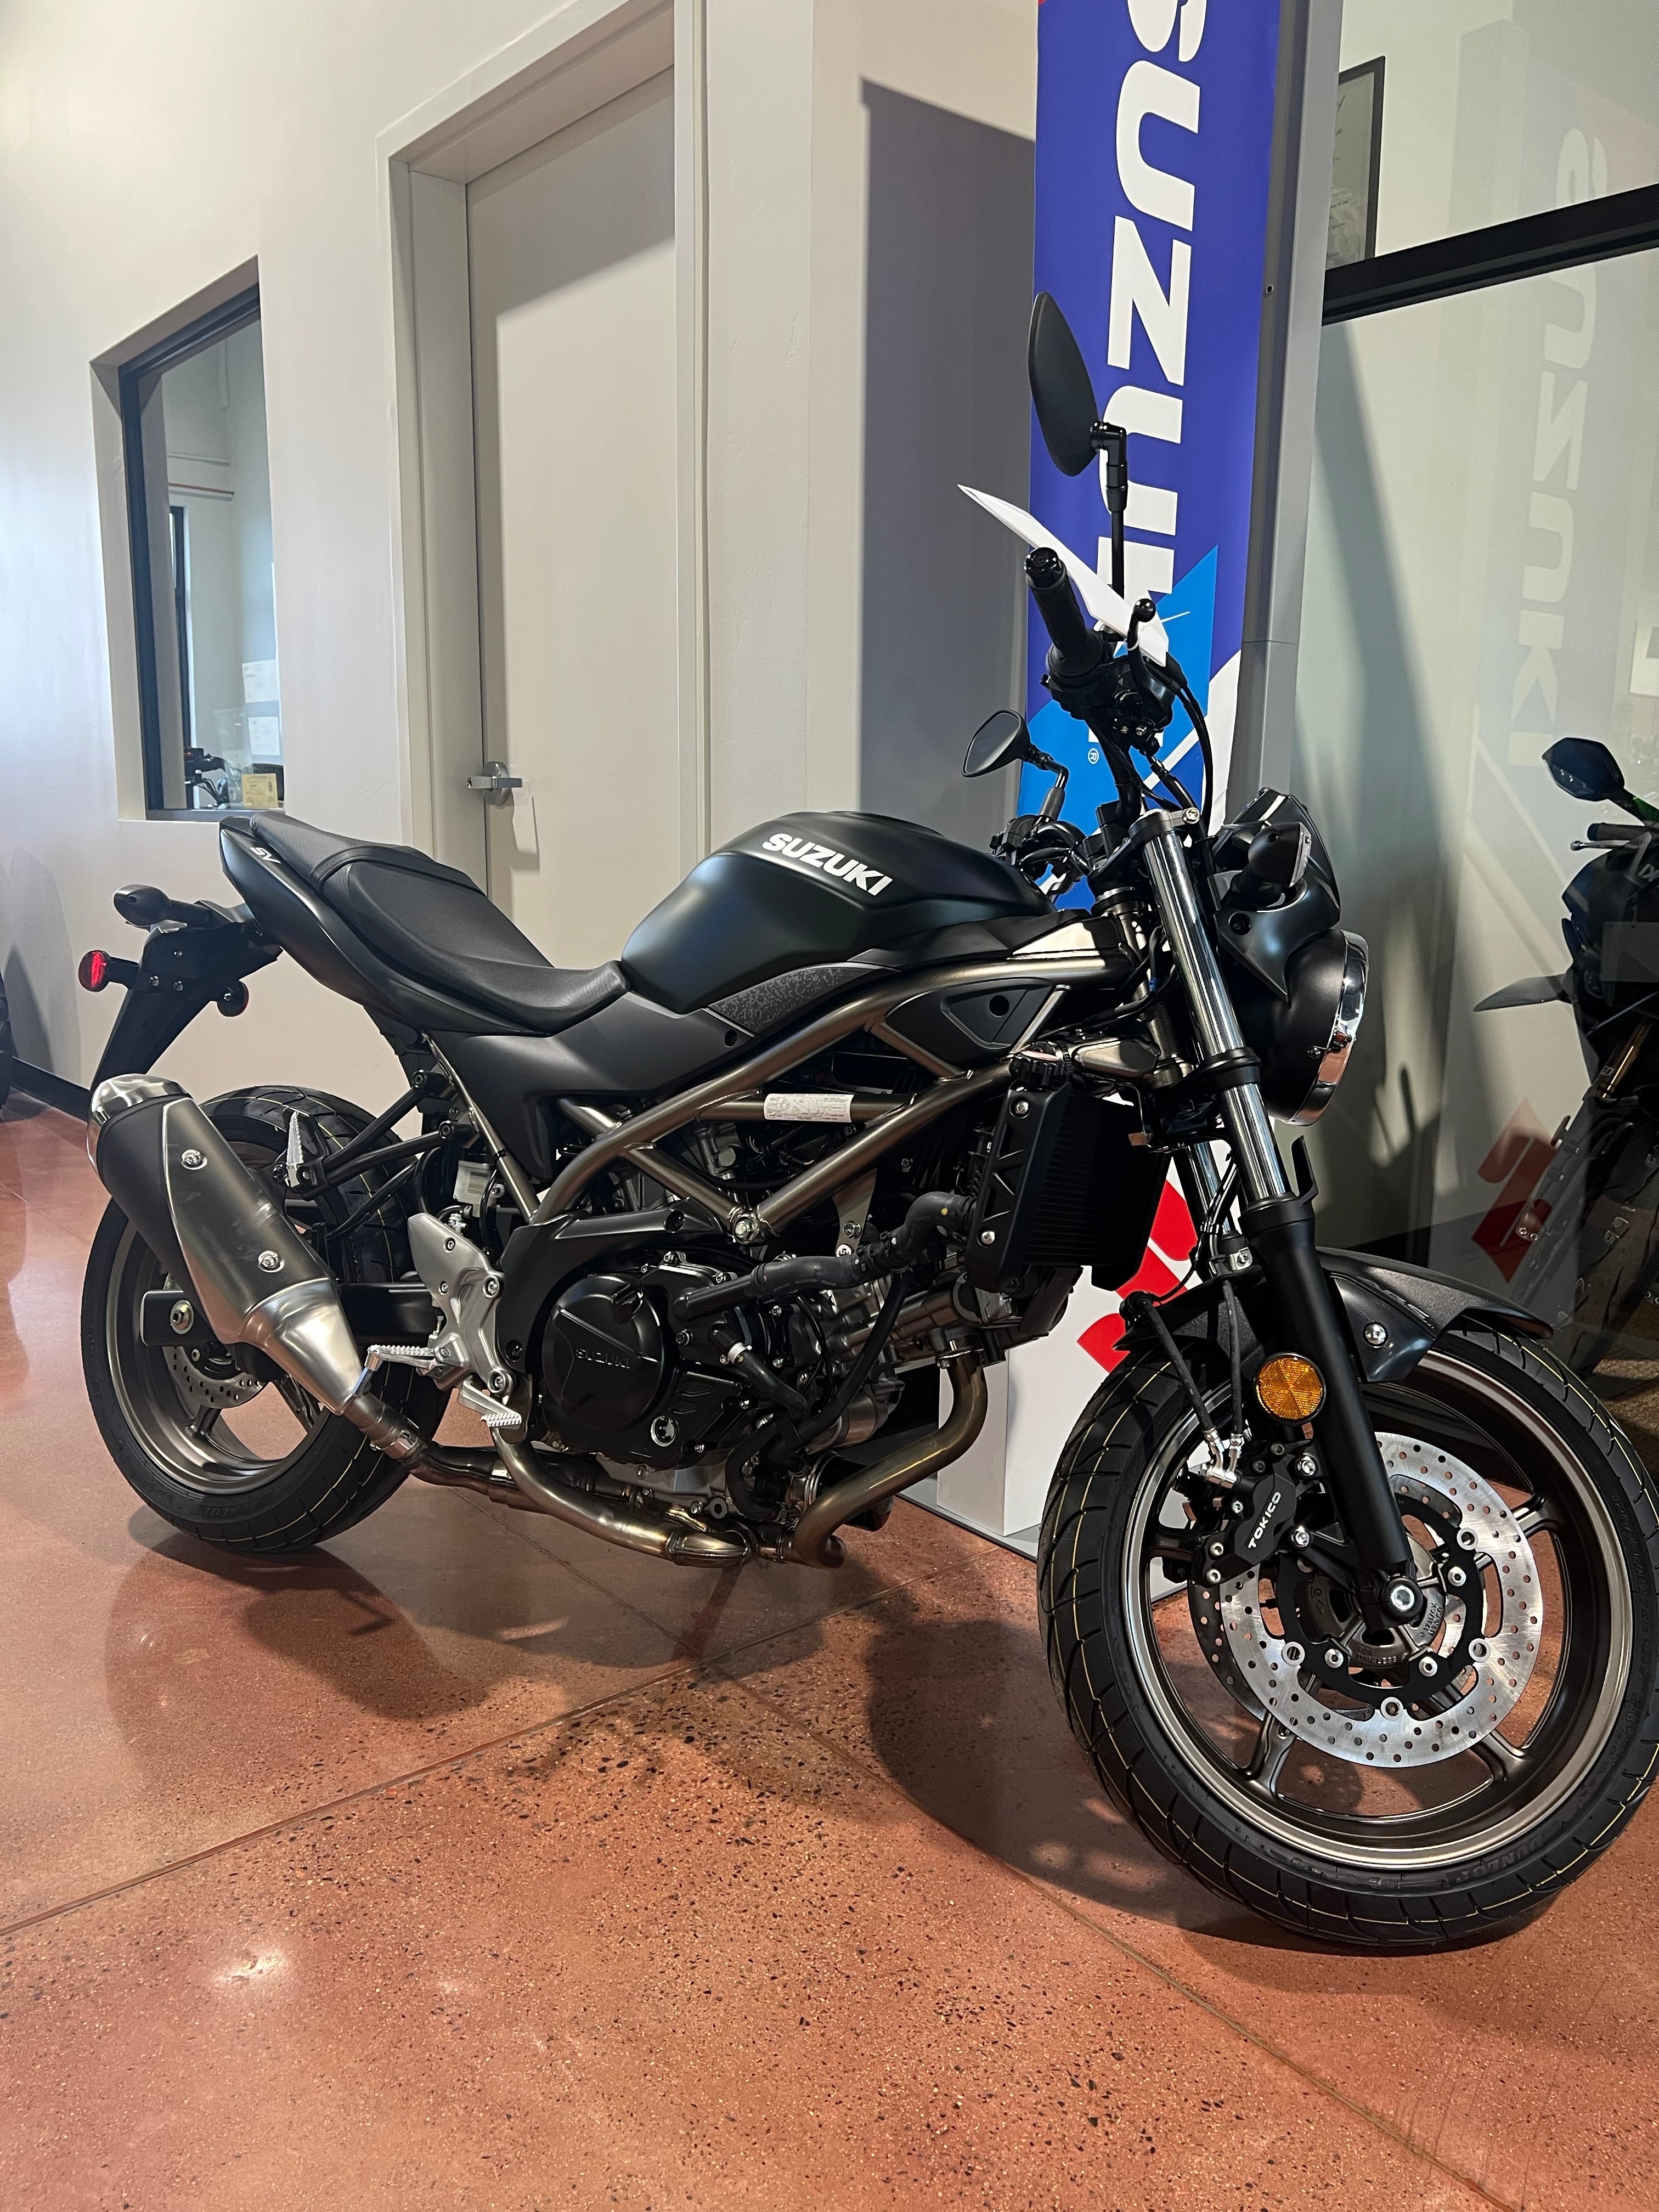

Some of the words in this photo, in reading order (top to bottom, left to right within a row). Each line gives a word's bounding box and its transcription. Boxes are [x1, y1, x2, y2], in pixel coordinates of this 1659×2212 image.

[1088, 0, 1207, 744] UZU
[250, 847, 281, 864] SV
[762, 833, 893, 896] SUZUKI
[576, 1348, 630, 1368] SUZUKI
[1248, 1492, 1282, 1548] TOKICO
